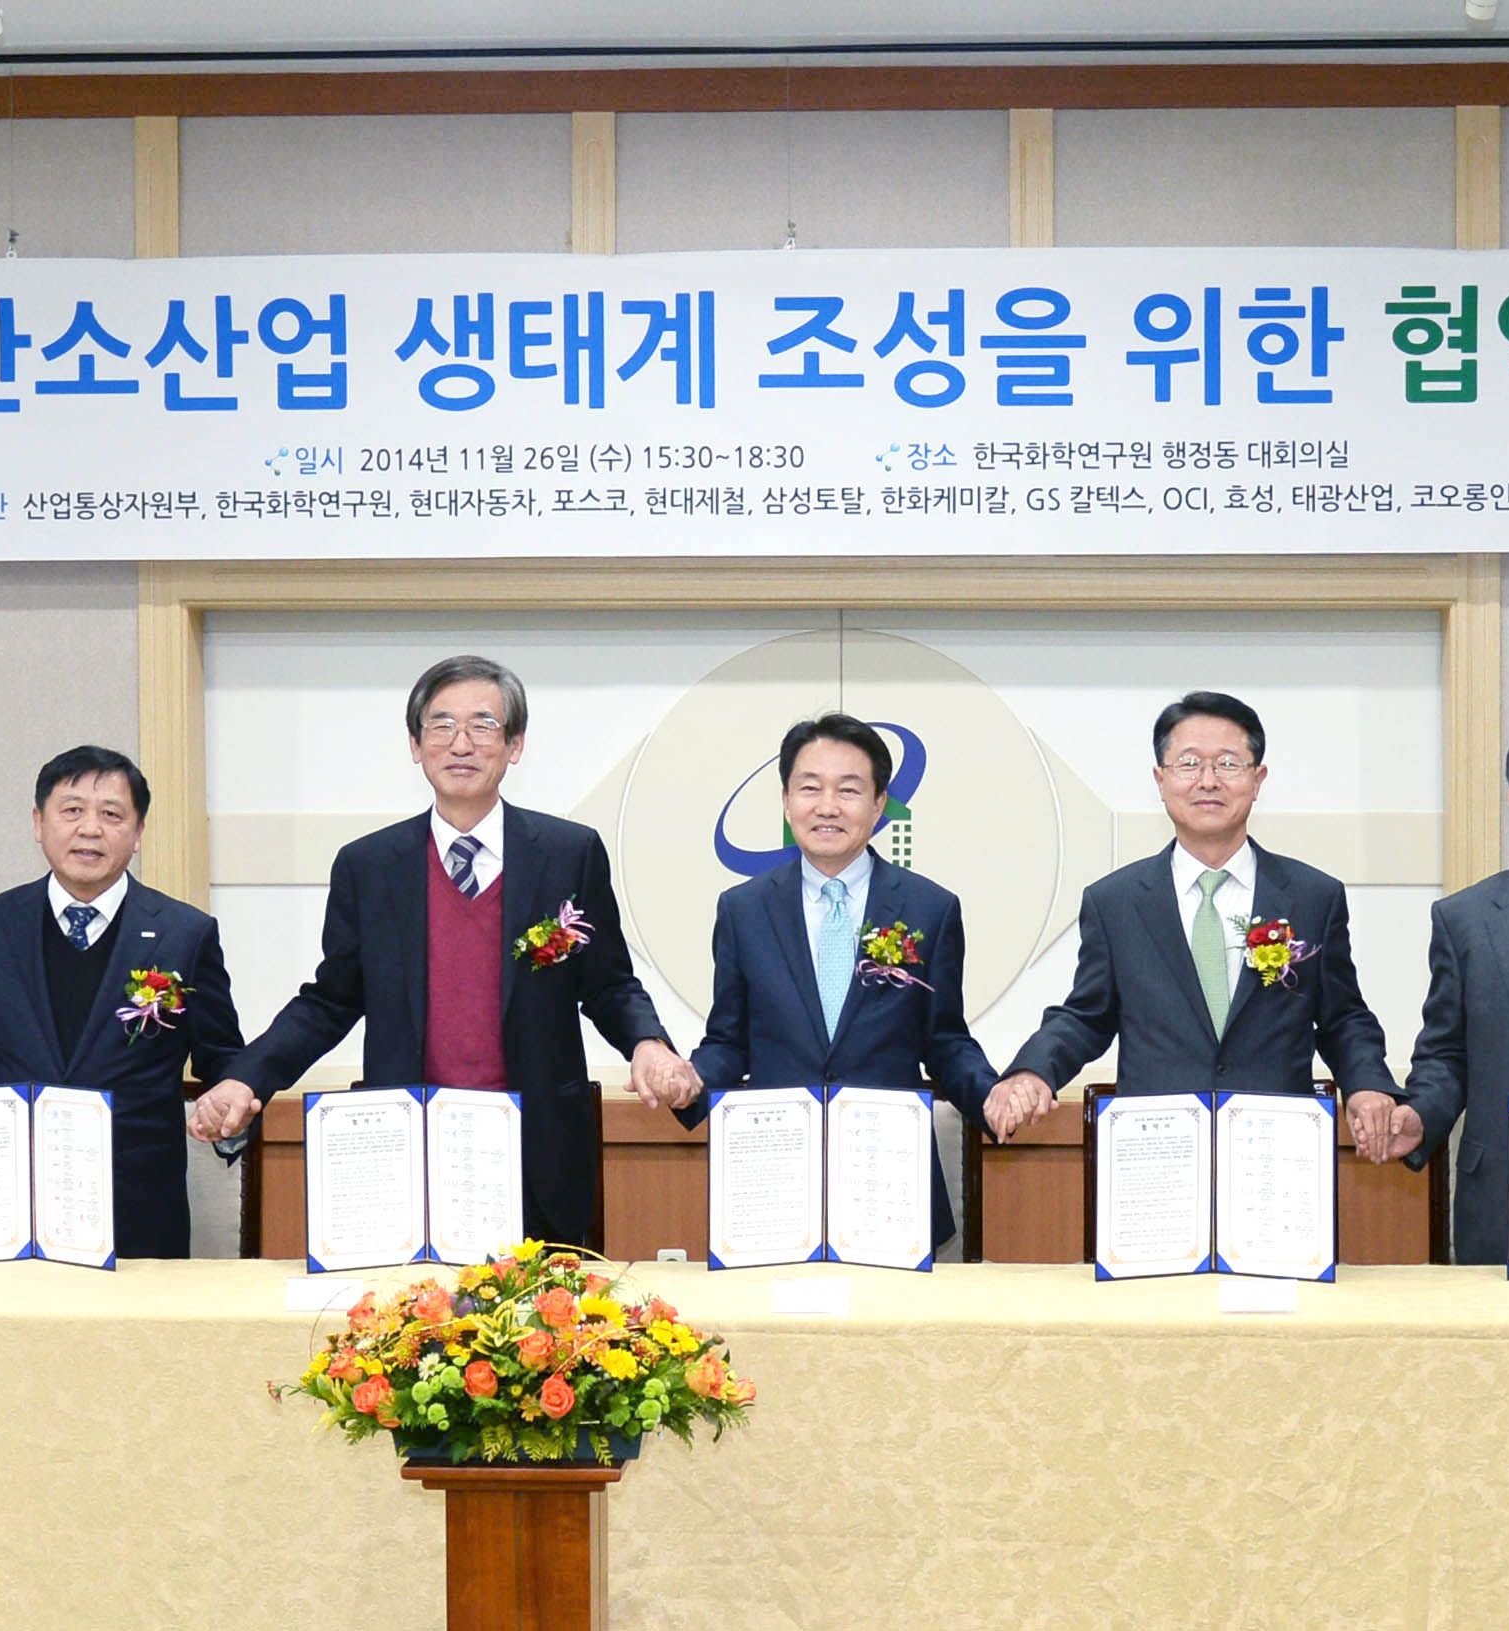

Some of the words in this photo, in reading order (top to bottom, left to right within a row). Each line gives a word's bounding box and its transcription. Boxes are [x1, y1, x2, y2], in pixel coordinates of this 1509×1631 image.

[395, 290, 715, 412] 생태계
[759, 287, 1086, 408] 조성을
[1126, 285, 1345, 407] 위한
[296, 447, 341, 475] 일시
[360, 446, 448, 474] 2014년
[460, 445, 514, 474] 11월
[524, 444, 579, 473] 26일
[589, 444, 632, 473] (수)
[643, 445, 804, 469] 15:30~18:30
[908, 443, 957, 471] 장소
[974, 442, 1152, 470] 한국화학연구원
[1162, 441, 1239, 469] 행정동
[1248, 440, 1349, 469] 대회의실
[23, 492, 206, 521] 산업통상자원부,
[216, 490, 399, 519] 한국화학연구원,
[410, 489, 542, 517] 현대자동차,
[552, 489, 634, 517] 포스코,
[645, 487, 752, 516] 현대제철,
[763, 486, 870, 516] 삼성토탈,
[881, 486, 1015, 515] 한화케미칼,
[1027, 487, 1060, 511] GS
[1071, 486, 1152, 515] 칼텍스,
[1164, 487, 1214, 514] OCI,
[1224, 484, 1281, 513] 효성,
[1293, 484, 1401, 512] 태광산업,
